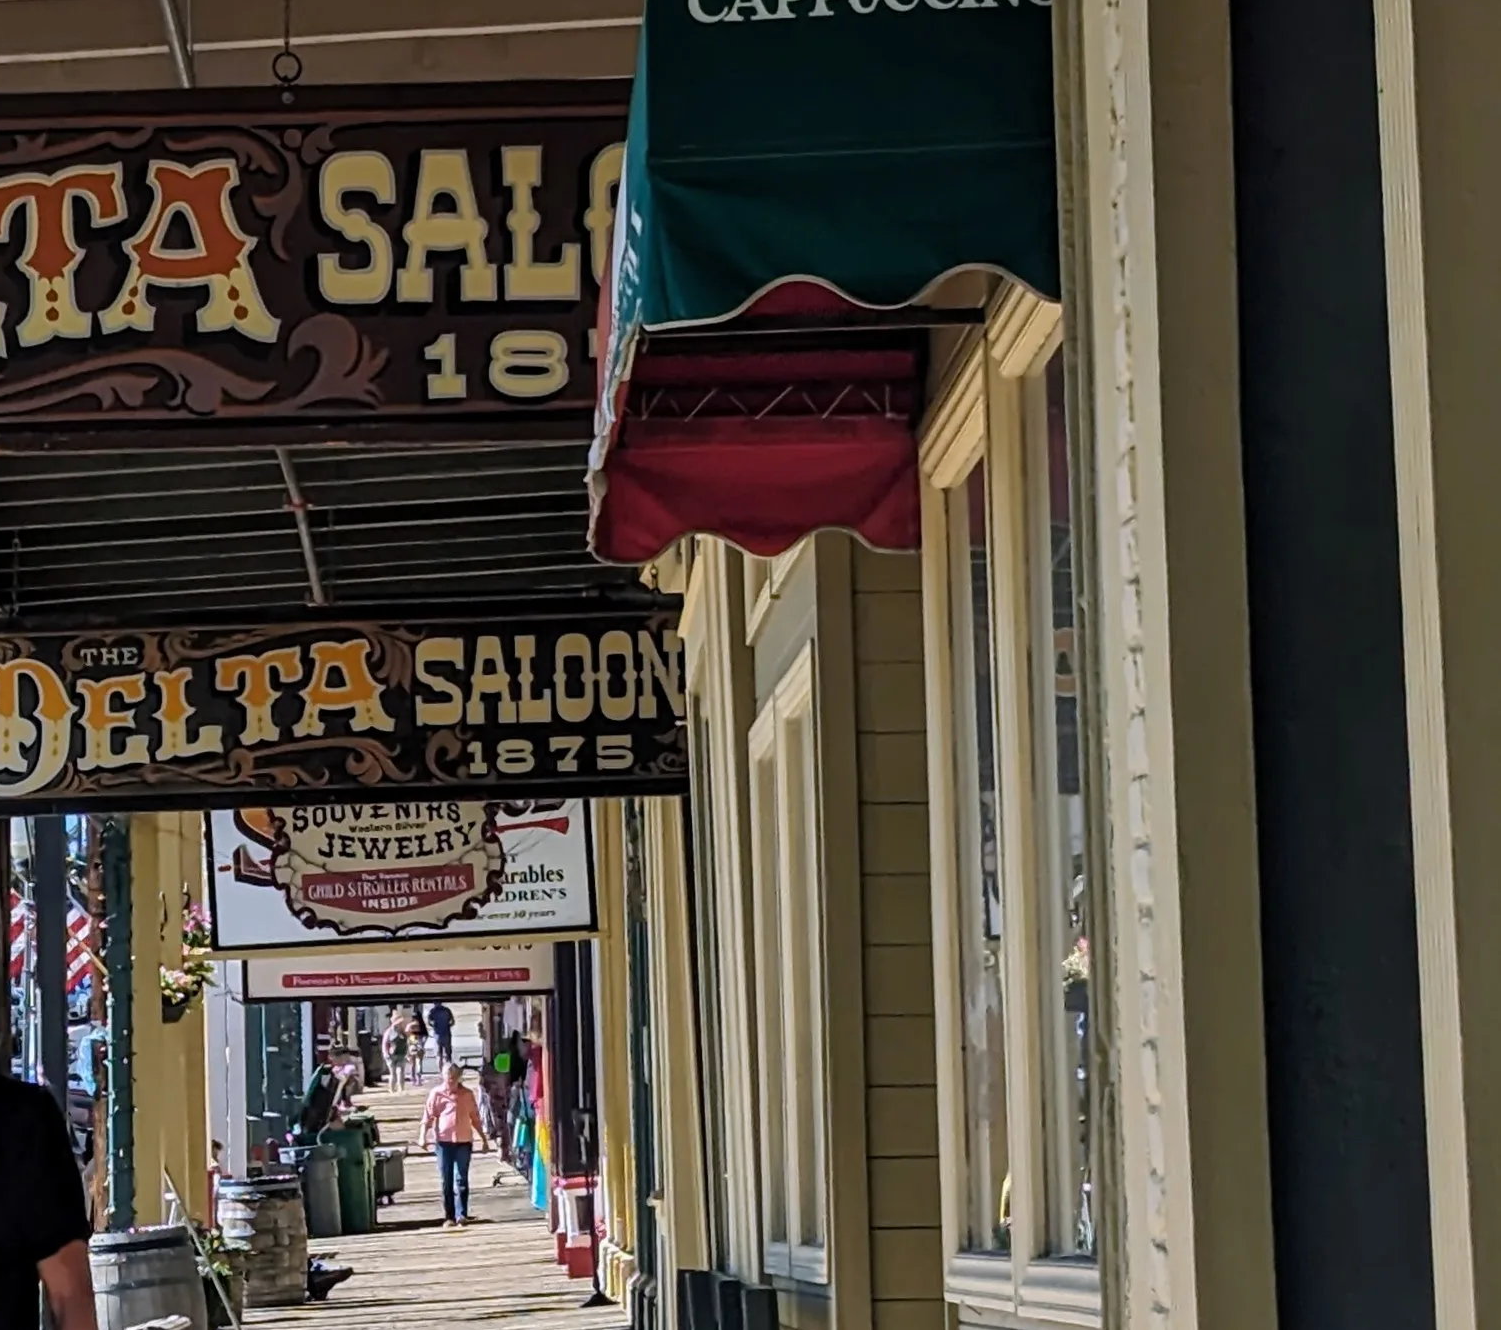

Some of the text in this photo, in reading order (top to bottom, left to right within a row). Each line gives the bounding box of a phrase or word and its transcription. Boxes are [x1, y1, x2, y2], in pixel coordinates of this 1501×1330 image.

[422, 329, 596, 400] 18
[80, 647, 139, 667] THE
[414, 629, 685, 727] SALOON
[466, 734, 635, 774] 1875
[292, 802, 461, 833] SOUVENIRS
[318, 821, 477, 860] JEWELRY
[308, 875, 468, 900] CHILD STROLLER RENTALS
[362, 897, 419, 910] INSIDE
